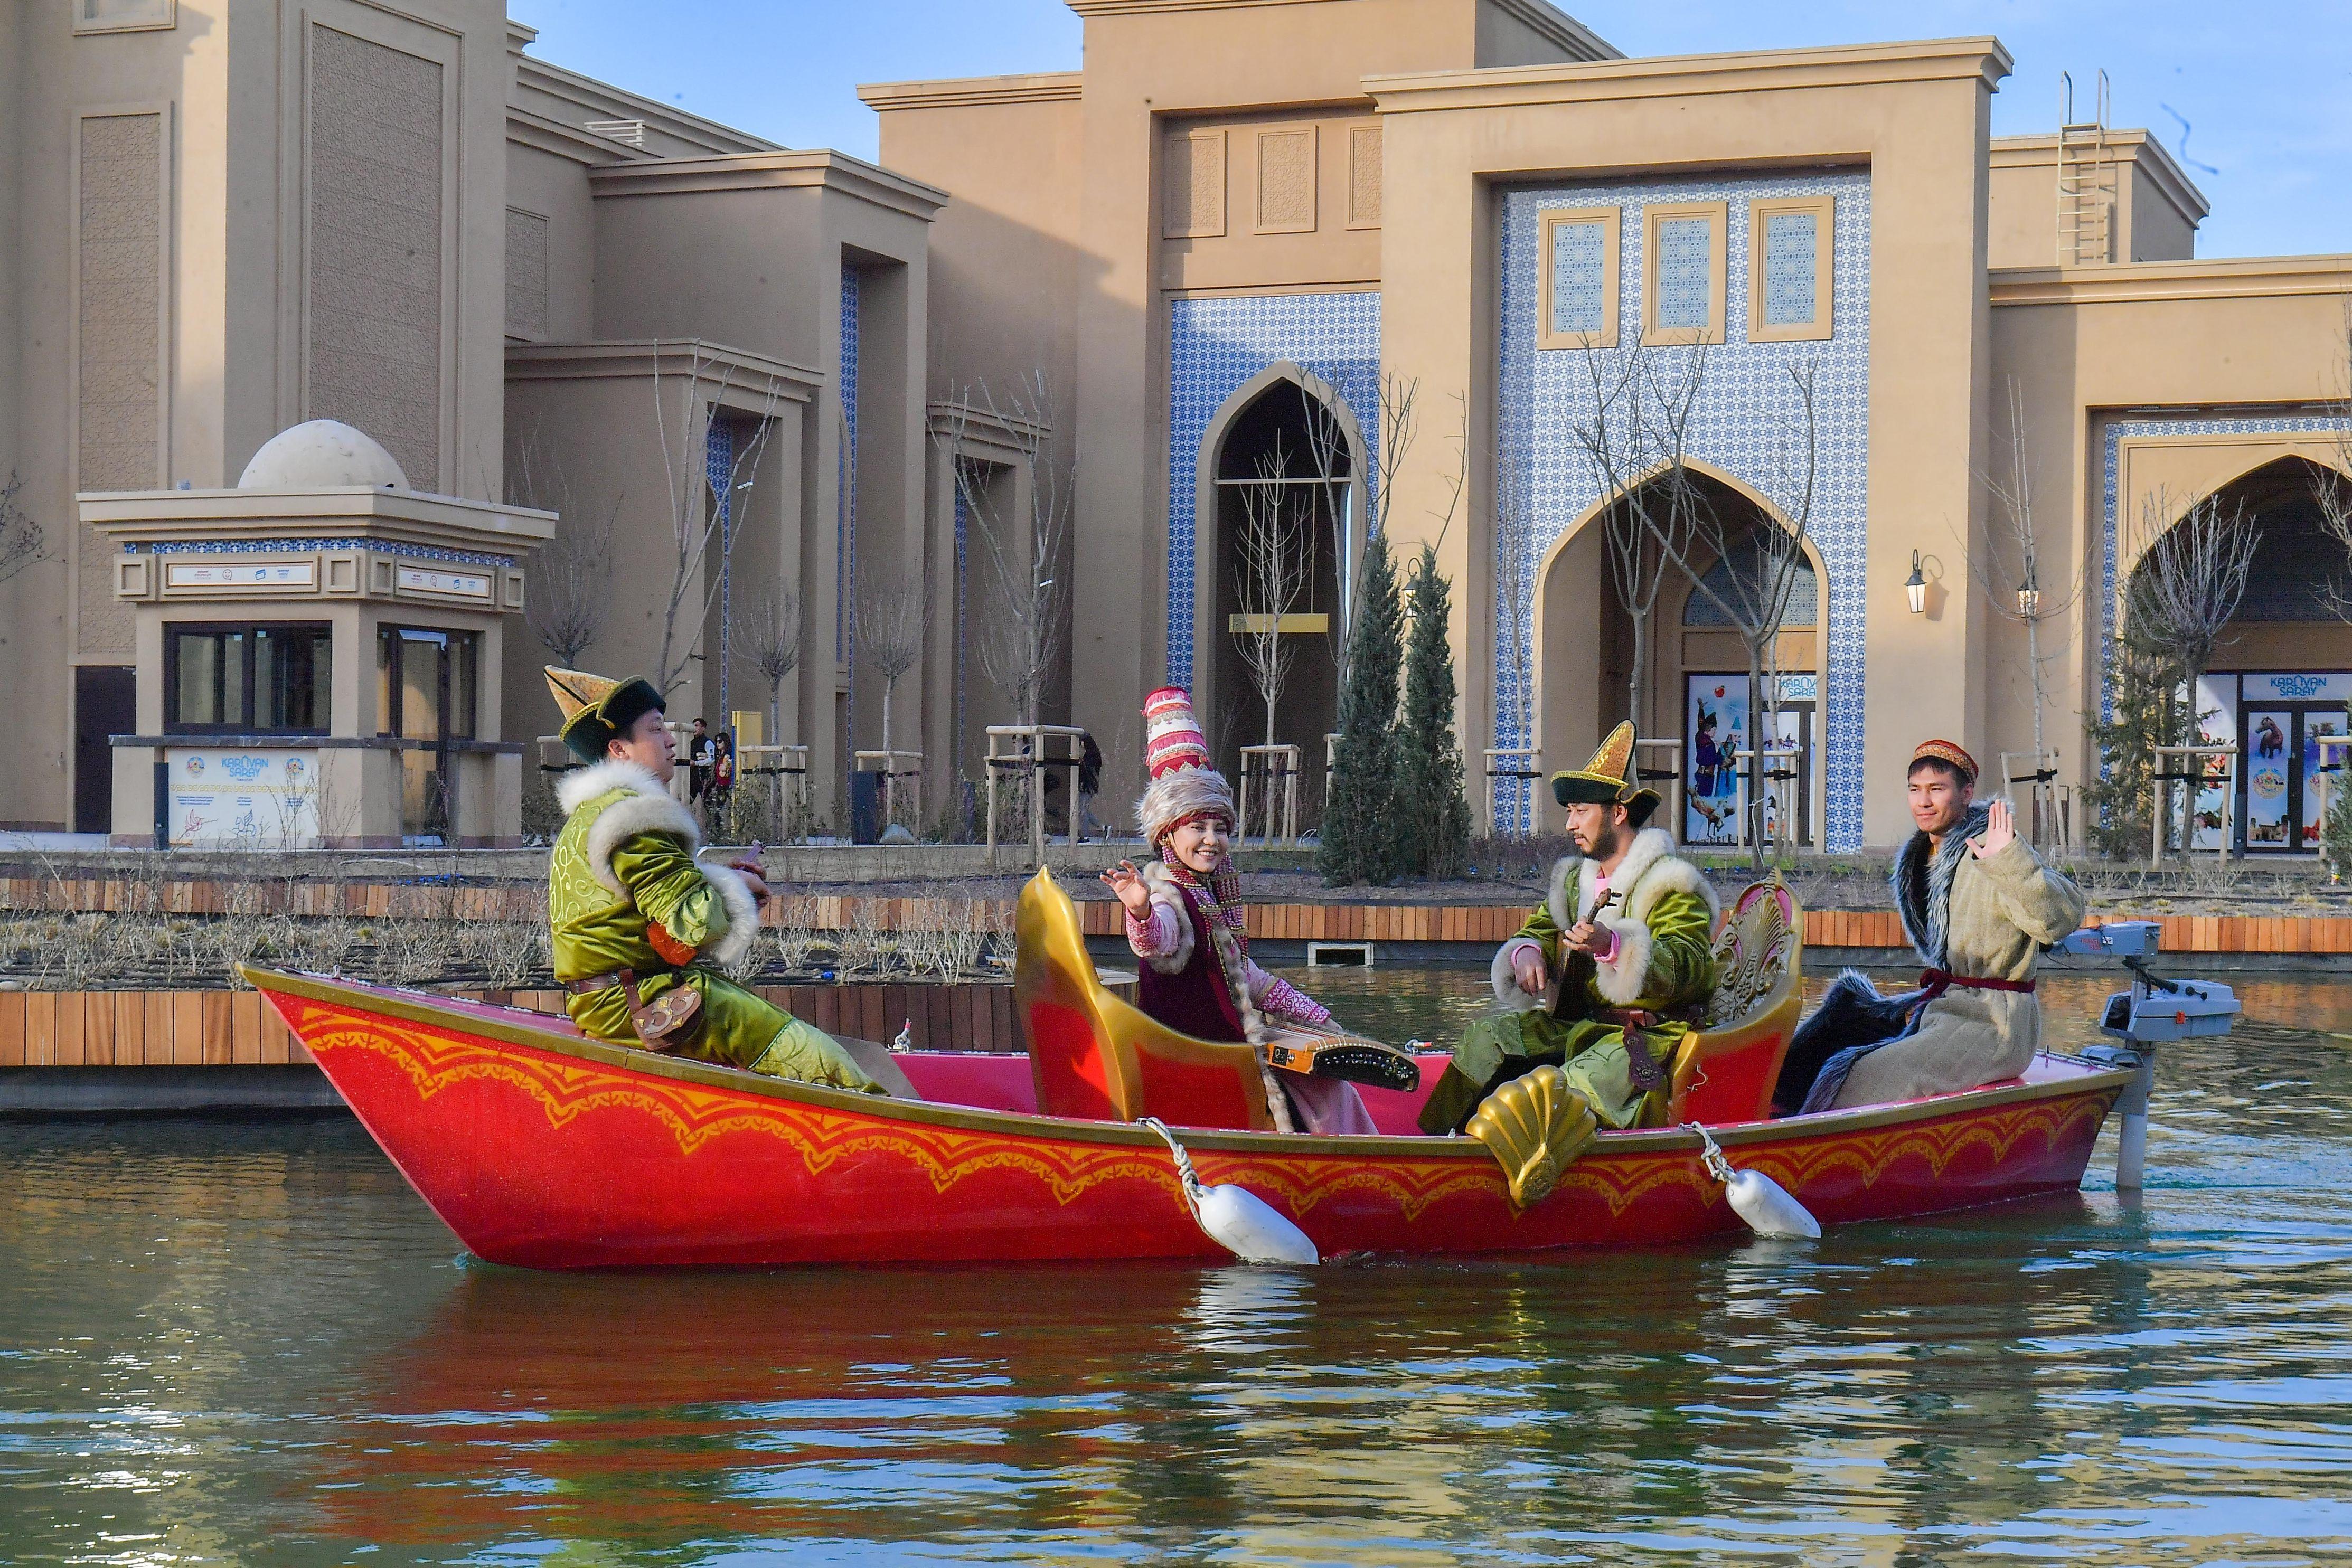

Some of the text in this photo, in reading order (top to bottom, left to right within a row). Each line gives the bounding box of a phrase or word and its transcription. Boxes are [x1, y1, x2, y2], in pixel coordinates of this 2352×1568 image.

[1788, 687, 1817, 697] SARA
[2280, 686, 2317, 696] SARAY
[229, 767, 260, 777] SARAY
